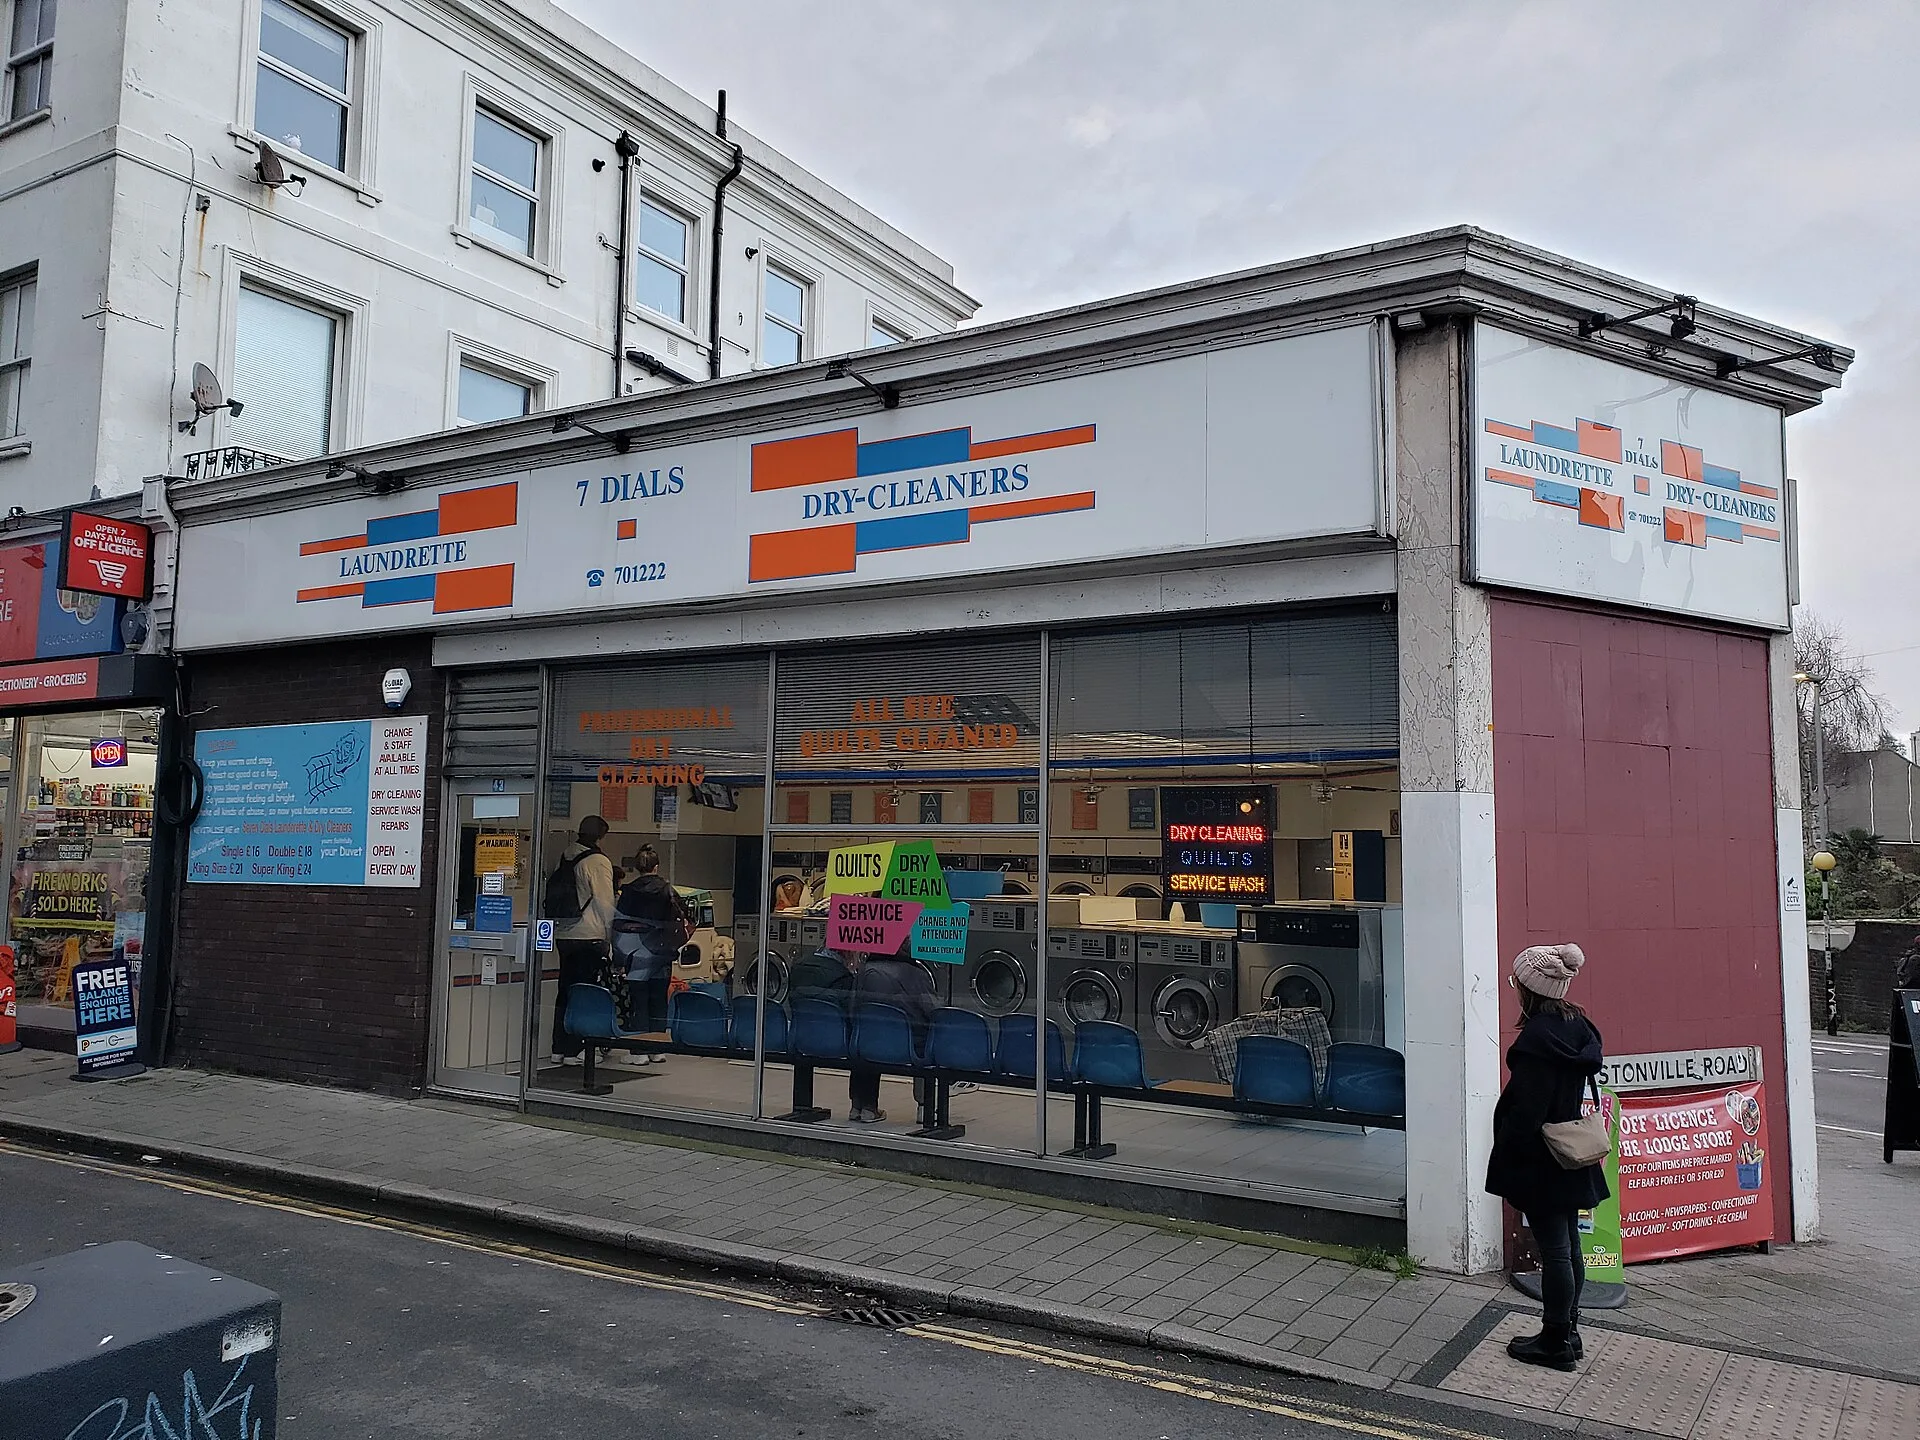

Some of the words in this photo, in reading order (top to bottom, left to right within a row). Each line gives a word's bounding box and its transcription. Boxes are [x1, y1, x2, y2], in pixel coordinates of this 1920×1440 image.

[1637, 437, 1644, 450] 7
[1500, 444, 1614, 487] LAUNDRETTE
[1625, 450, 1658, 469] DIALS
[576, 480, 590, 507] 7
[600, 466, 684, 505] DIALS
[802, 463, 1030, 520] DRY-CLEANERS
[1666, 482, 1776, 522] DRY-CLEANERS
[1638, 513, 1661, 525] 701222
[84, 529, 106, 541] DAYS
[107, 534, 113, 542] A
[114, 535, 138, 547] WEEK
[95, 524, 118, 535] OPEN
[73, 536, 97, 549] OFF
[98, 542, 144, 559] LICENCE
[339, 540, 467, 578] LAUNDRETTE
[614, 562, 666, 585] 701222
[43, 672, 87, 687] GROCERIES
[852, 696, 894, 722] ALL
[903, 694, 956, 720] SIZE
[579, 704, 735, 733] PROFESSIONAL
[384, 728, 413, 737] CHANGE
[800, 729, 881, 758] QUILTS
[895, 723, 1018, 750] CLEANED
[94, 746, 120, 760] OPEN
[384, 742, 389, 750] &
[391, 741, 412, 749] STAFF
[630, 736, 673, 759] DRY
[379, 753, 415, 762] AVAILABLE
[374, 767, 382, 775] AT
[384, 766, 397, 775] ALL
[400, 765, 419, 774] TIMES
[597, 763, 705, 788] CLEANING
[371, 790, 385, 799] DRY
[387, 789, 421, 799] CLEANING
[493, 779, 504, 792] 43
[371, 806, 399, 815] SERVICE
[400, 806, 421, 815] WASH
[381, 821, 409, 830] REPAIRS
[1170, 825, 1197, 840] DRY
[1199, 825, 1263, 841] CLEANING
[221, 845, 244, 859] Single
[268, 845, 296, 857] Double
[320, 848, 338, 859] your
[339, 846, 362, 857] Duvet
[372, 845, 395, 857] OPEN
[485, 839, 514, 848] WARNING
[835, 853, 881, 878] QUILTS
[900, 854, 930, 873] DRY
[1181, 850, 1252, 866] QUILTS
[193, 862, 209, 876] King
[212, 862, 227, 874] Size
[252, 863, 274, 877] Super
[276, 863, 295, 878] King
[370, 864, 397, 875] EVERY
[400, 864, 416, 875] DAY
[30, 872, 108, 892] FIREWORKS
[890, 877, 942, 896] CLEAN
[1170, 874, 1226, 891] SERVICE
[1228, 876, 1265, 892] WASH
[37, 896, 68, 912] SOLD
[70, 896, 98, 913] HERE
[838, 903, 903, 921] SERVICE
[918, 916, 947, 926] CHANGE
[950, 916, 966, 927] AND
[838, 926, 884, 945] WASH
[921, 928, 963, 940] ATTENDENT
[76, 966, 128, 991] FREE
[79, 986, 129, 1001] BALANCE
[79, 995, 129, 1010] ENQUIRIES
[81, 1003, 132, 1026] HERE
[1703, 1054, 1748, 1077] ROAD
[1620, 1115, 1647, 1135] OFF
[1653, 1108, 1718, 1131] LICENCE
[1644, 1134, 1690, 1155] LODGE
[1693, 1130, 1733, 1149] STORE
[1637, 1163, 1647, 1172] OF
[1647, 1162, 1661, 1172] OUR
[1662, 1160, 1680, 1170] ITEMS
[1681, 1158, 1693, 1168] ARE
[1693, 1156, 1710, 1167] PRICE
[1710, 1152, 1732, 1164] MARKED
[1628, 1179, 1641, 1189] ELF
[1641, 1178, 1655, 1188] BAR
[1655, 1177, 1659, 1186] 3
[1660, 1176, 1673, 1185] FOR
[1687, 1173, 1696, 1182] OR
[1701, 1170, 1713, 1180] FOR
[1626, 1210, 1660, 1223] ALCOHOL
[1664, 1202, 1707, 1218] NEWSPAPERS
[1711, 1194, 1759, 1211] CONFECTIONERY
[1642, 1222, 1667, 1236] CANDY
[1671, 1220, 1689, 1231] SOFT
[1689, 1216, 1713, 1228] DRINKS
[1716, 1213, 1727, 1225] ICE
[1727, 1210, 1748, 1223] CREAM
